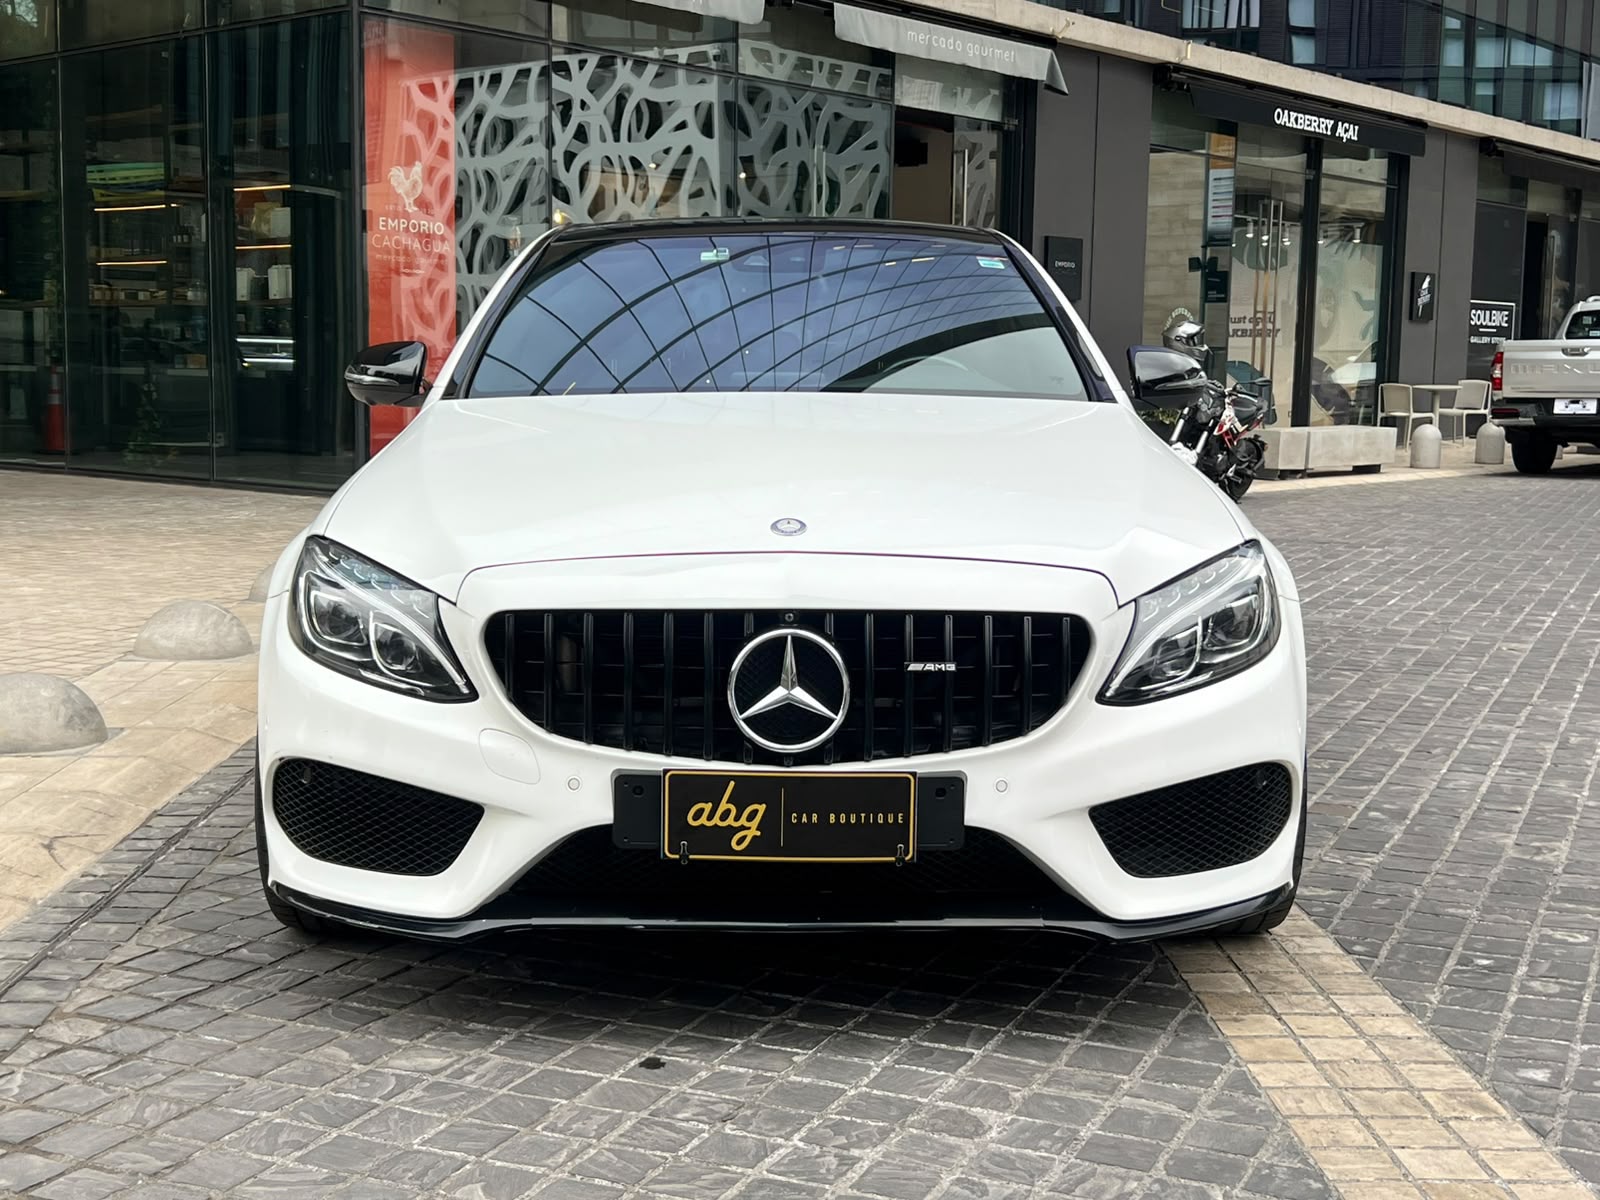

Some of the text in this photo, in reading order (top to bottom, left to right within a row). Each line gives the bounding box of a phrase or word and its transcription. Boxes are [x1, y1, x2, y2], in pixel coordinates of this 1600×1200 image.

[907, 30, 1015, 63] mercado gourmet
[1274, 108, 1359, 143] OAKBERRY AÇAI
[379, 217, 445, 235] EMPORIO
[372, 233, 450, 253] CACHAGUA
[1470, 309, 1509, 327] SOULBIKE
[1229, 328, 1281, 338] KBERRY
[923, 663, 956, 671] AMG
[686, 780, 767, 851] abg
[791, 813, 904, 824] CAR BOUTIQUE
